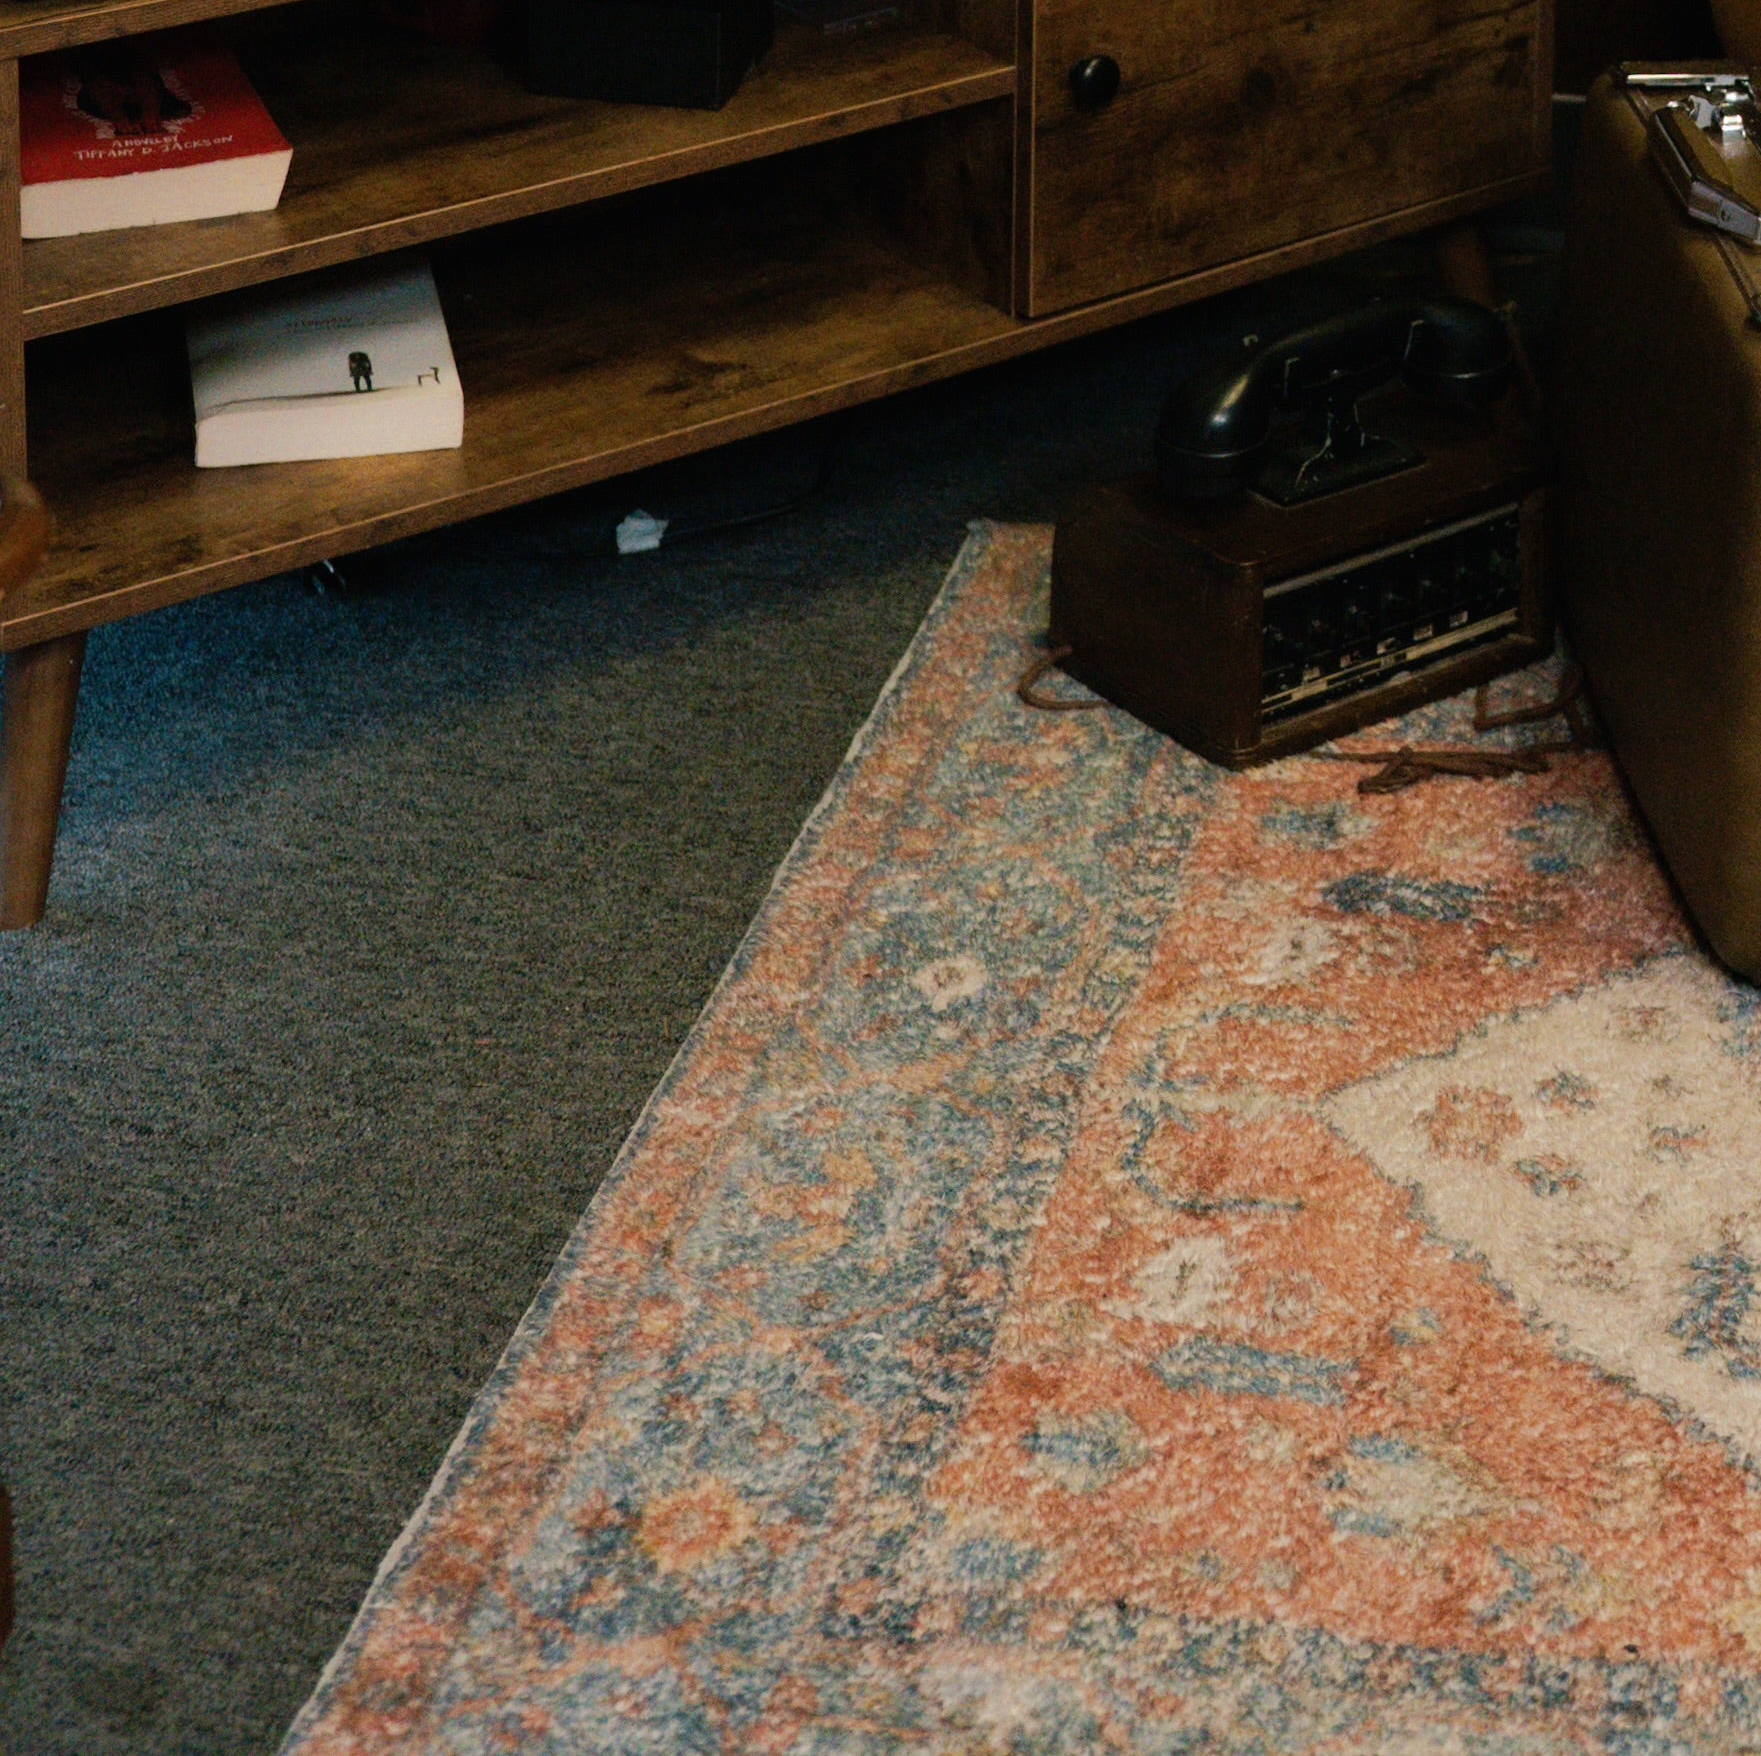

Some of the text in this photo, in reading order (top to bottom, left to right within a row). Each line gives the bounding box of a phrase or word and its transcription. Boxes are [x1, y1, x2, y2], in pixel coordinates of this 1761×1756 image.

[74, 147, 135, 161] TIFFANY
[162, 134, 234, 153] JACKSON
[111, 138, 122, 148] A
[162, 133, 179, 144] BY
